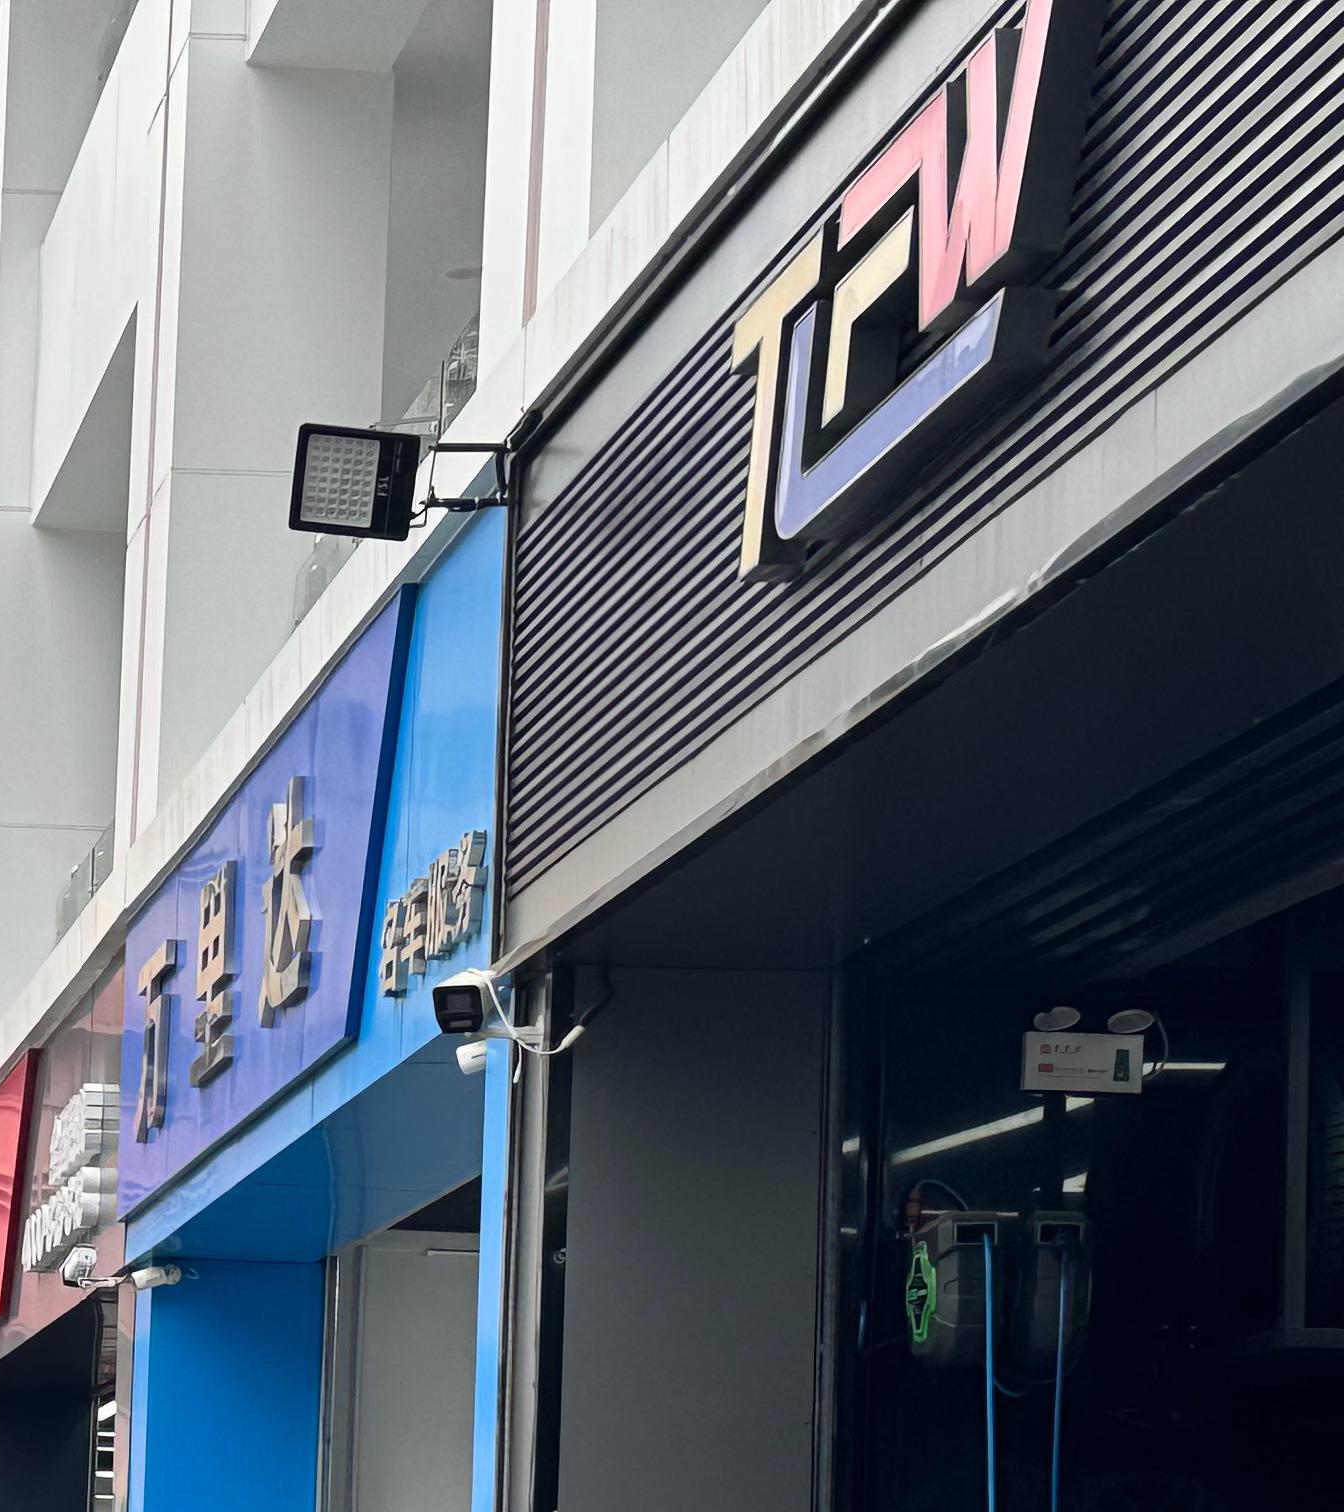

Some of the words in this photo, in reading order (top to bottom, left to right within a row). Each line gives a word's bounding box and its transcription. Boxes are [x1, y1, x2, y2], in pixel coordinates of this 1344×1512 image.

[135, 775, 314, 1143] 万里达
[379, 829, 489, 997] 名车服务
